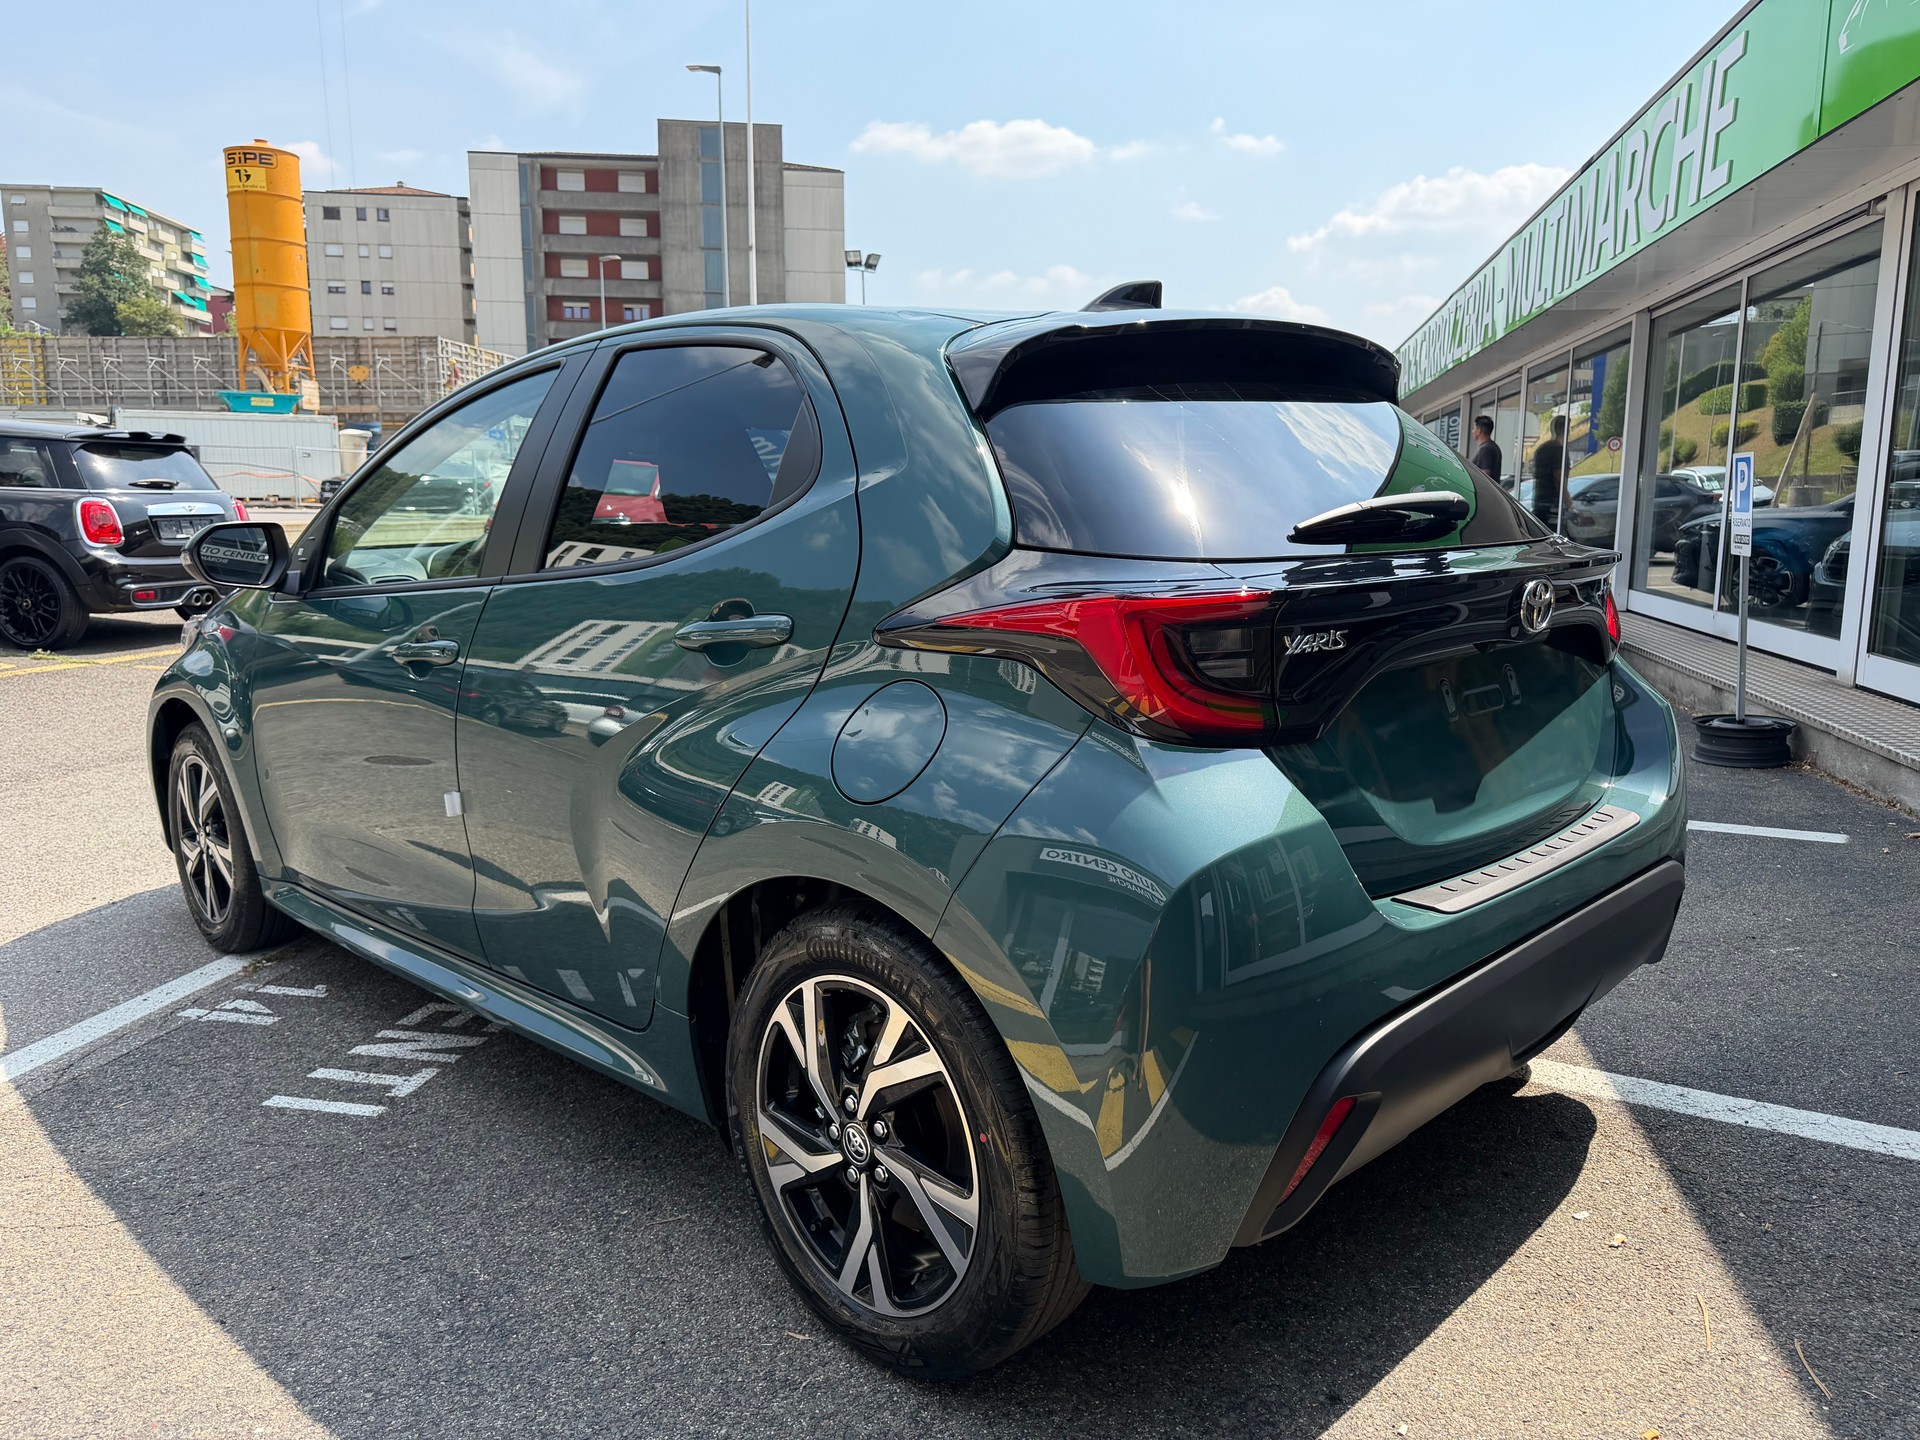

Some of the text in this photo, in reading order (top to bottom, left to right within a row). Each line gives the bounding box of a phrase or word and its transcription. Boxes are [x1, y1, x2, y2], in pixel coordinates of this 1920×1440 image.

[1417, 266, 1496, 385] CARROZZERIA
[1503, 29, 1749, 329] MULTIMARCHE
[1737, 461, 1749, 509] P
[222, 550, 266, 561] CENTRO
[1284, 629, 1349, 656] YARIS
